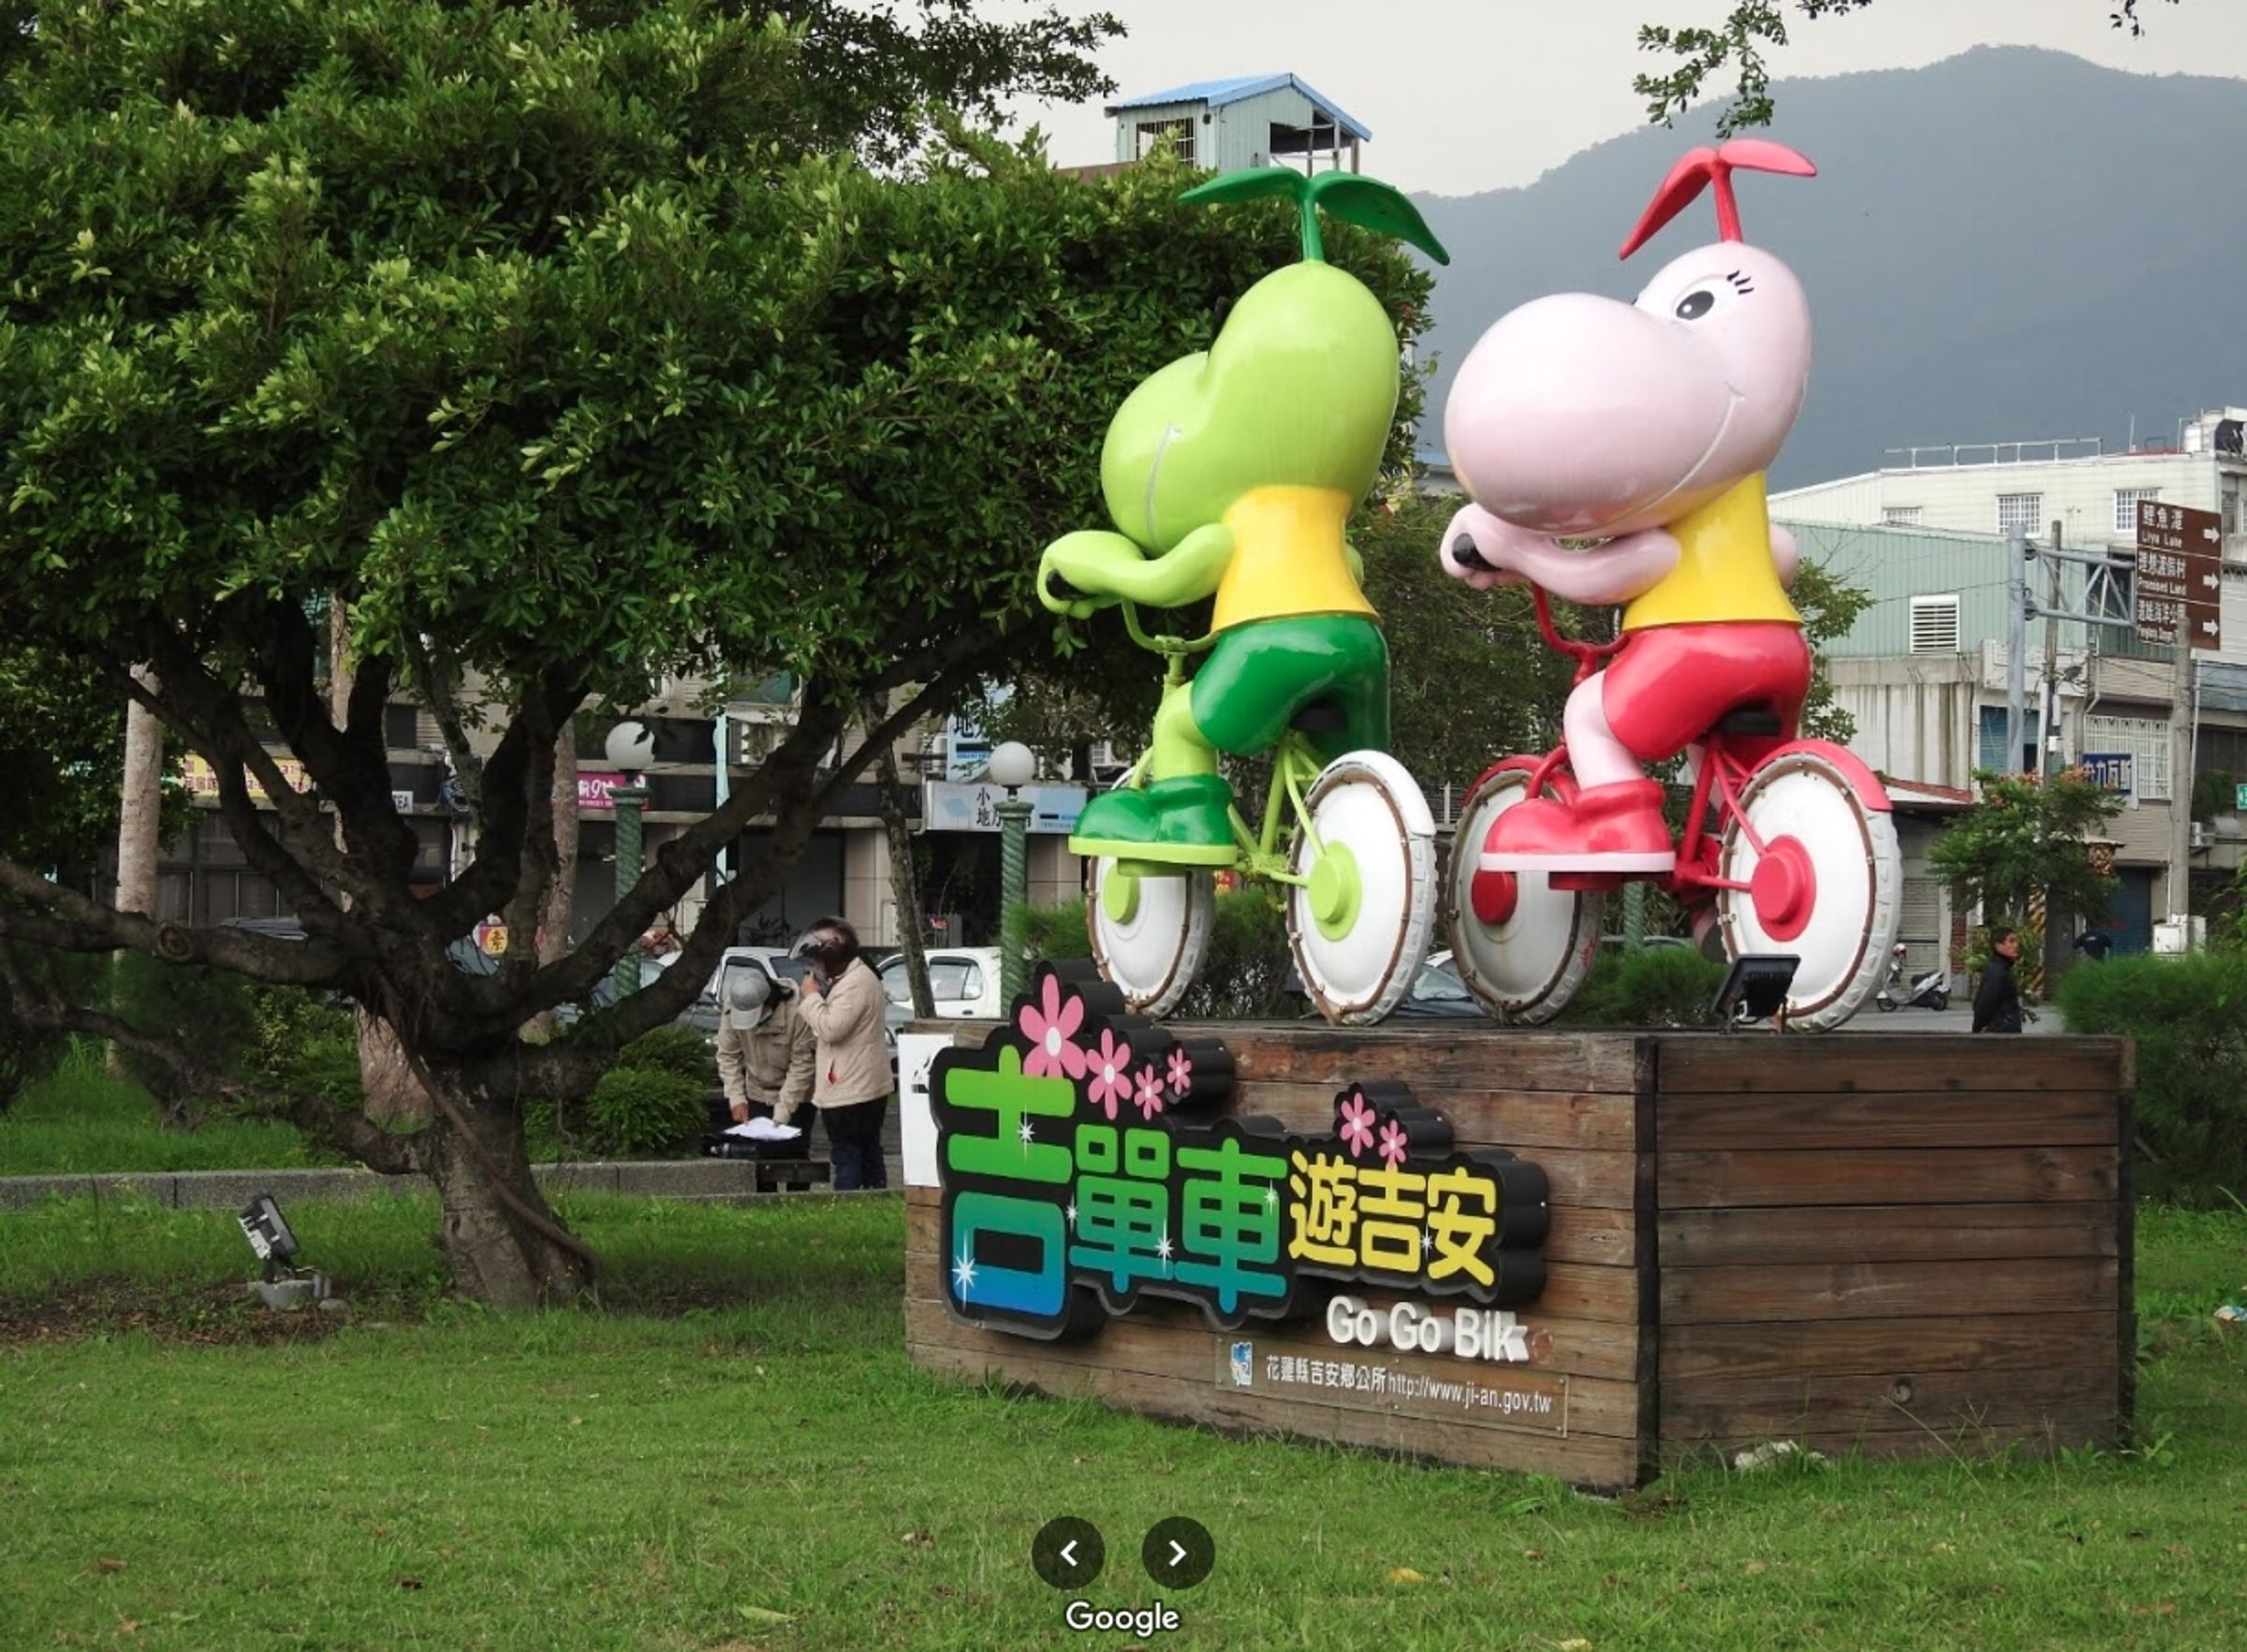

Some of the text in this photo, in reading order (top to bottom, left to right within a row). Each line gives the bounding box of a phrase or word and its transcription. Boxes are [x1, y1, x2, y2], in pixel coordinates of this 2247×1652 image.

[1327, 1295, 1378, 1346] Go
[1390, 1302, 1443, 1352] Go
[1388, 1375, 1552, 1415] http://www.ji-an.gov.tw
